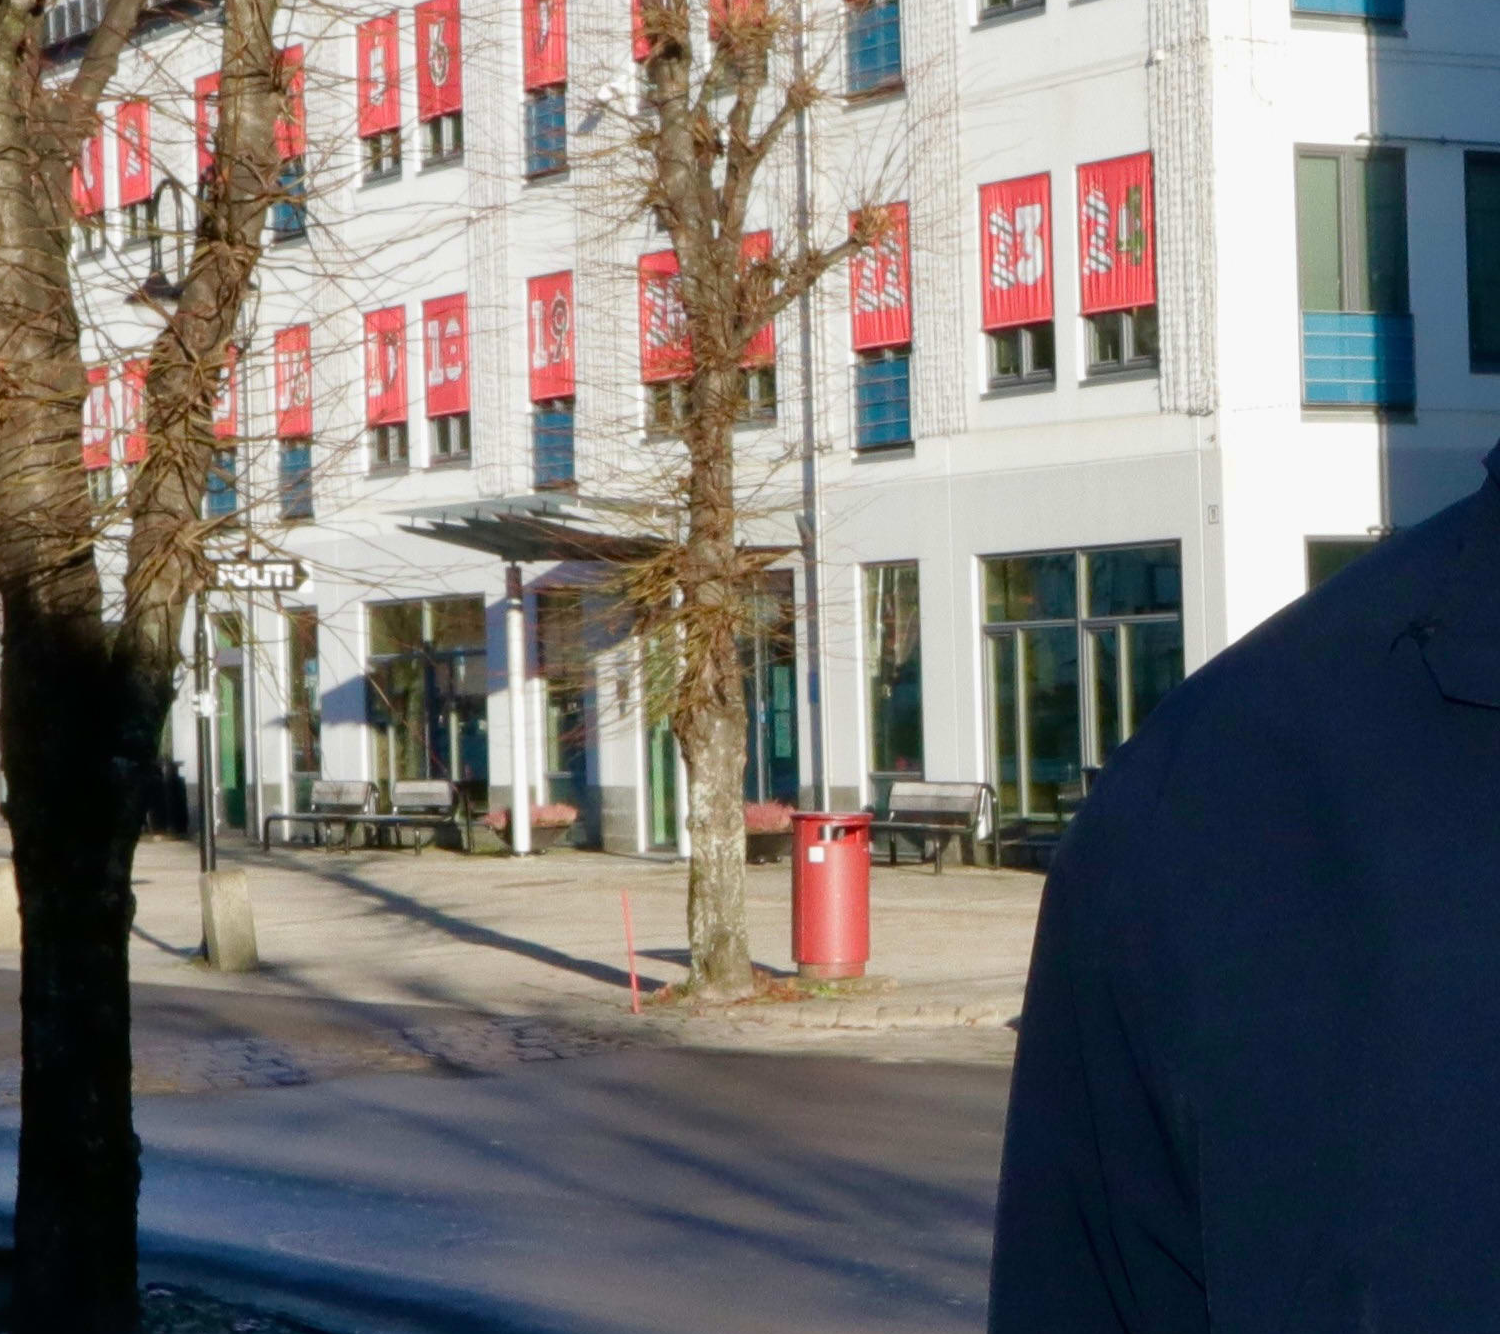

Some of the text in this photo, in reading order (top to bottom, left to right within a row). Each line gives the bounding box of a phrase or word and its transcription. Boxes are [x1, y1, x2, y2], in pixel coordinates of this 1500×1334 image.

[988, 202, 1044, 291] 23
[1082, 183, 1146, 275] 24
[532, 290, 569, 370] 19
